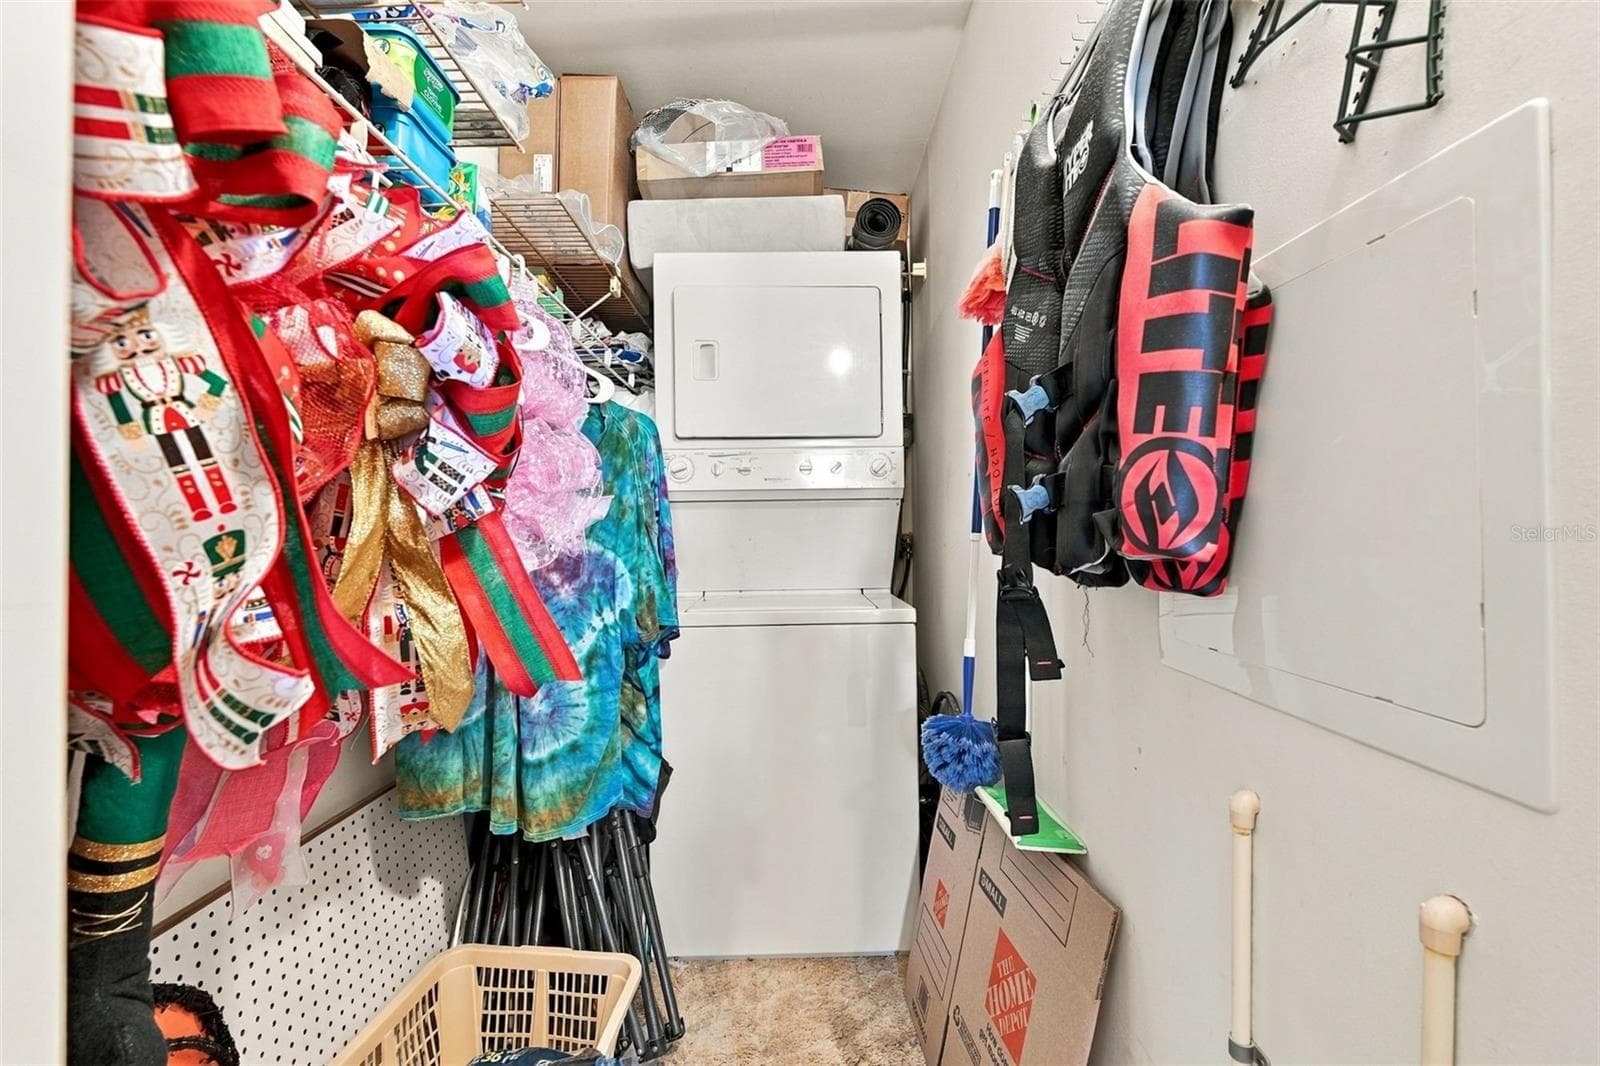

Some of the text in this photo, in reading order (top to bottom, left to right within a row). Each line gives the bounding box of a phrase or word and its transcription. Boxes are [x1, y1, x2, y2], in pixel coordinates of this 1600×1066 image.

[980, 874, 1005, 913] SMALL
[996, 955, 1014, 978] THE
[987, 967, 1035, 1017] HOME
[999, 1007, 1028, 1036] DEPOT
